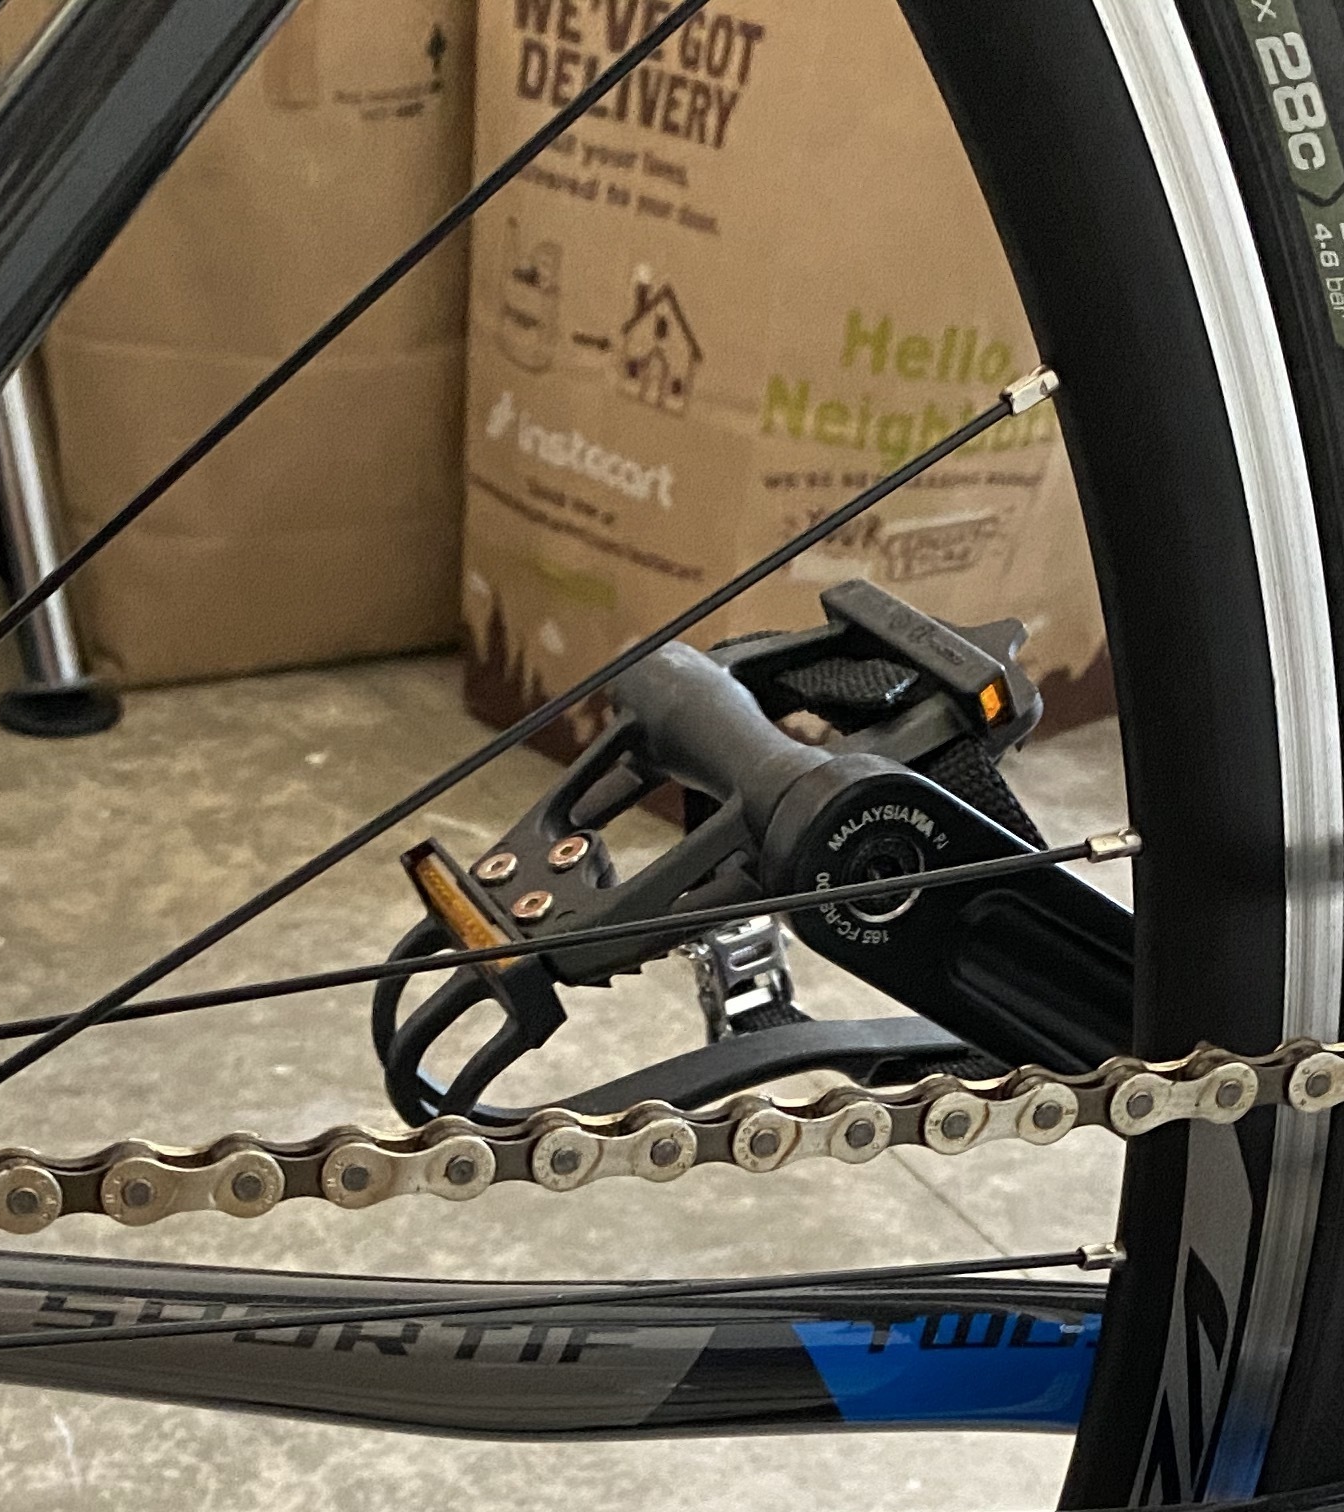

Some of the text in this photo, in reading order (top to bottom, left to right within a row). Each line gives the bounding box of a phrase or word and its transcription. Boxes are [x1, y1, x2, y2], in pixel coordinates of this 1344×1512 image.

[680, 8, 763, 86] GOT
[516, 36, 739, 150] DELIVERY
[841, 308, 1013, 385] Hello
[827, 804, 909, 851] MALAYSIA
